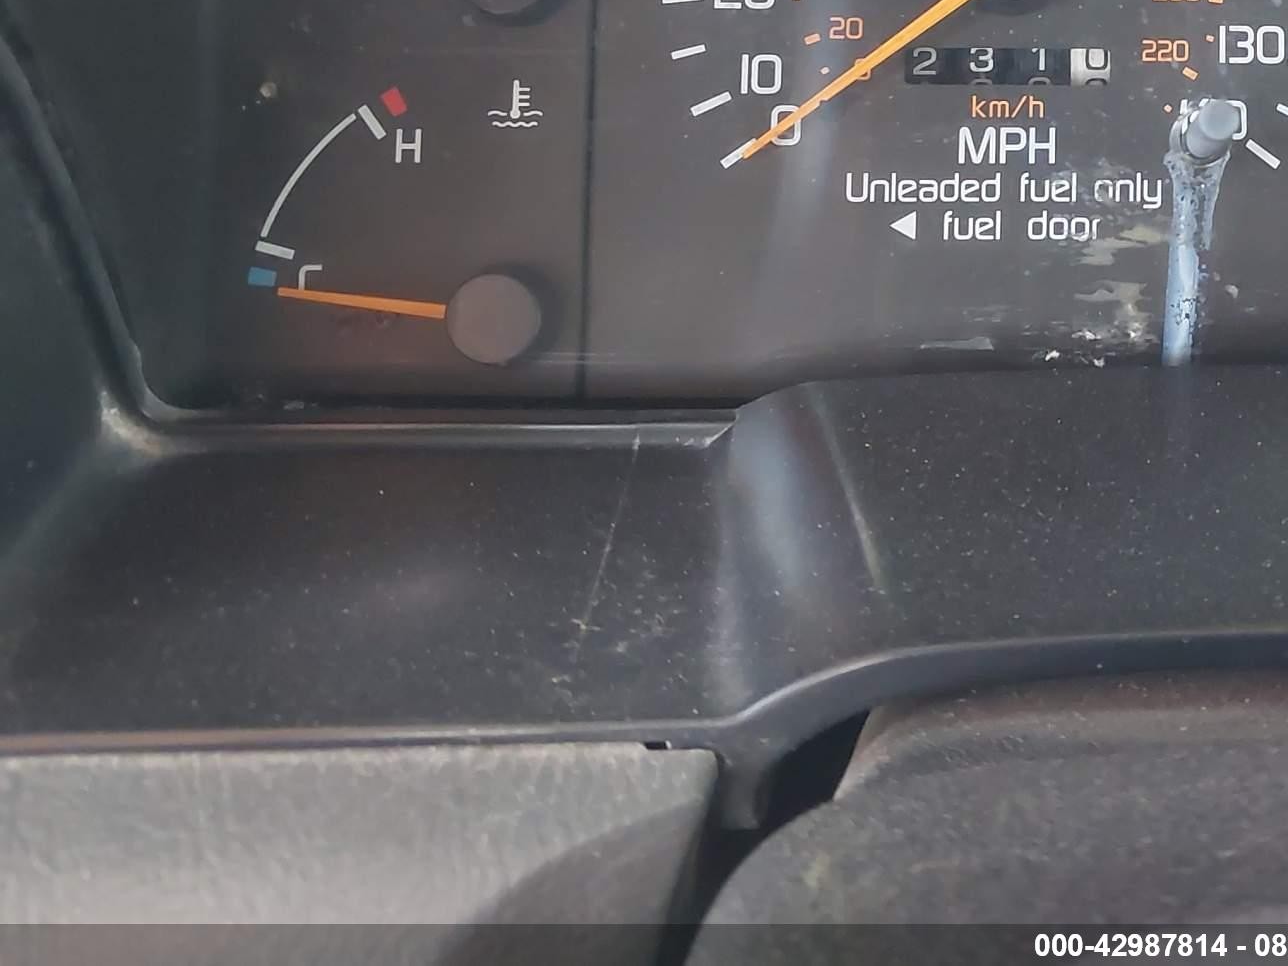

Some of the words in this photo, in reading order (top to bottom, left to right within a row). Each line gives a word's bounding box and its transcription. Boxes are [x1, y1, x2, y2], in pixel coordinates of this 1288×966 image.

[829, 17, 863, 40] 20
[1218, 25, 1286, 65] 130
[1141, 40, 1190, 62] 220
[740, 53, 783, 95] 10
[770, 104, 802, 146] 0
[971, 95, 1046, 119] km/h
[395, 128, 423, 164] H
[957, 125, 1057, 165] MPH
[845, 172, 1001, 204] Unleaded
[1020, 172, 1078, 204] fuel
[1095, 172, 1163, 210] only
[942, 210, 1001, 241] fuel
[1027, 210, 1102, 241] door
